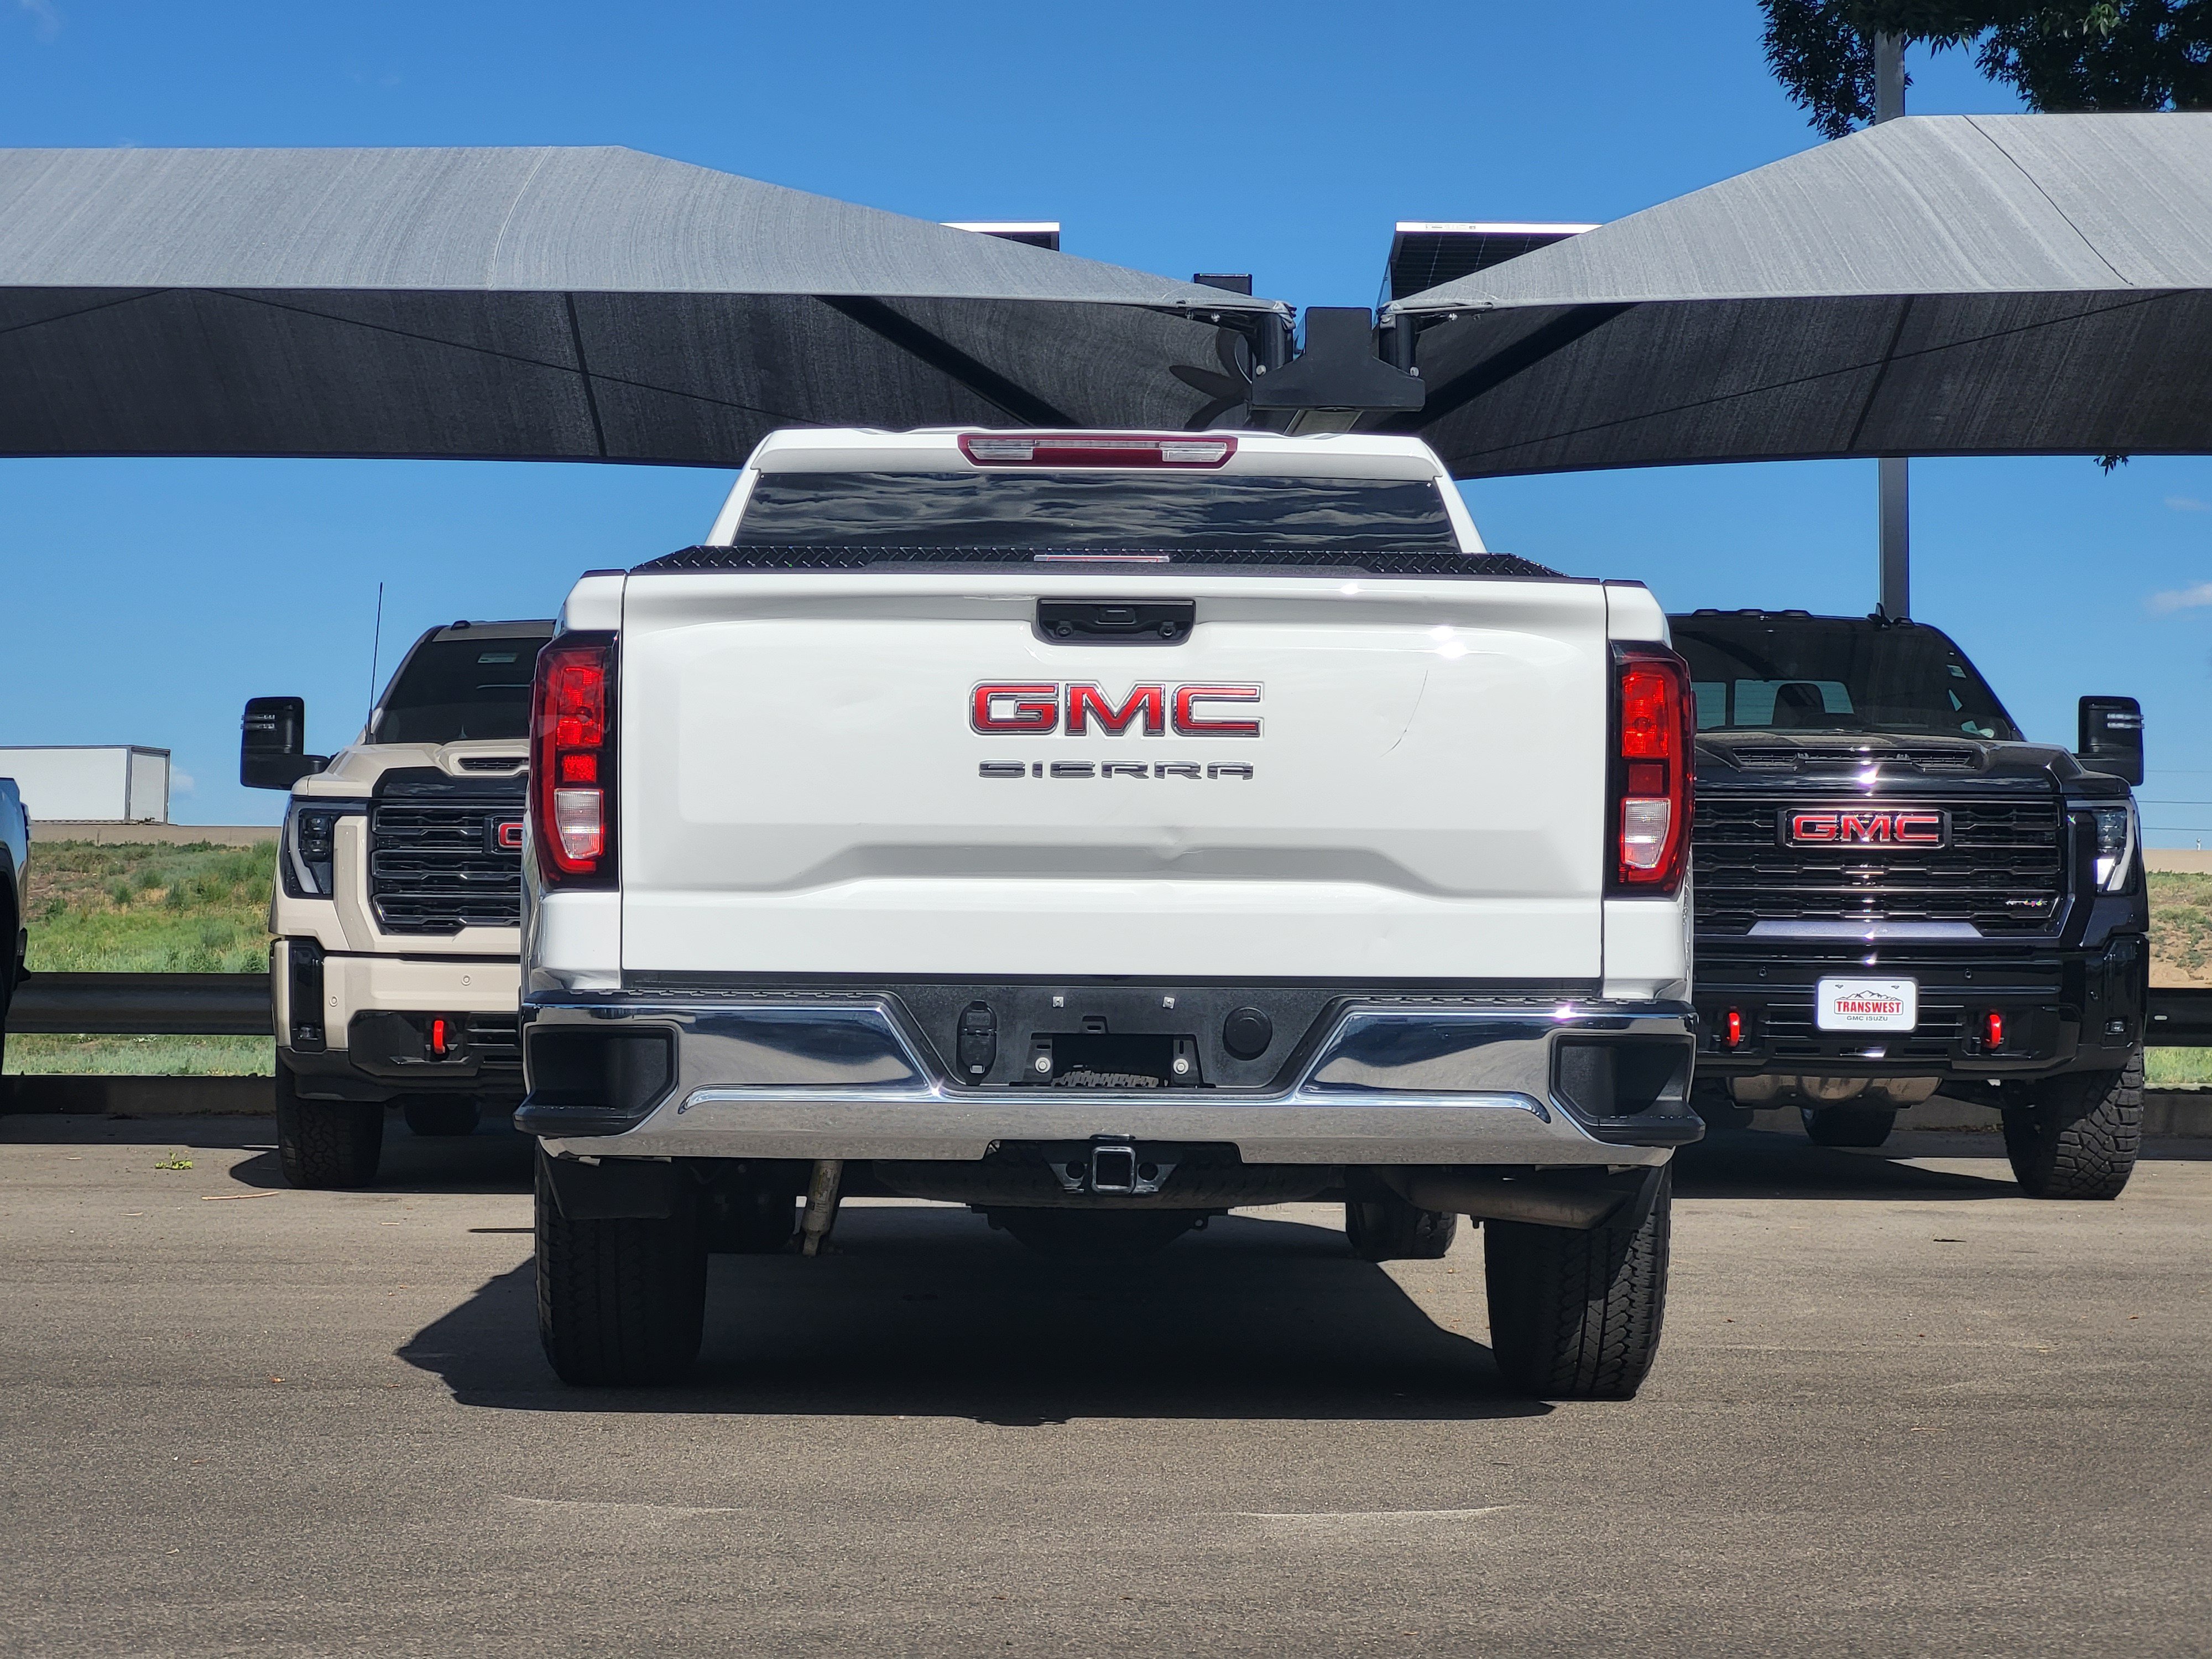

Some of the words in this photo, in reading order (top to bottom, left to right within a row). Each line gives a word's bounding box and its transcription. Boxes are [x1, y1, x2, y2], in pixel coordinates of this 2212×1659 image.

[969, 679, 1264, 737] GMC
[978, 760, 1254, 780] SIERRA
[1793, 814, 1939, 842] GMC
[1836, 1001, 1901, 1013] TRANSWEST
